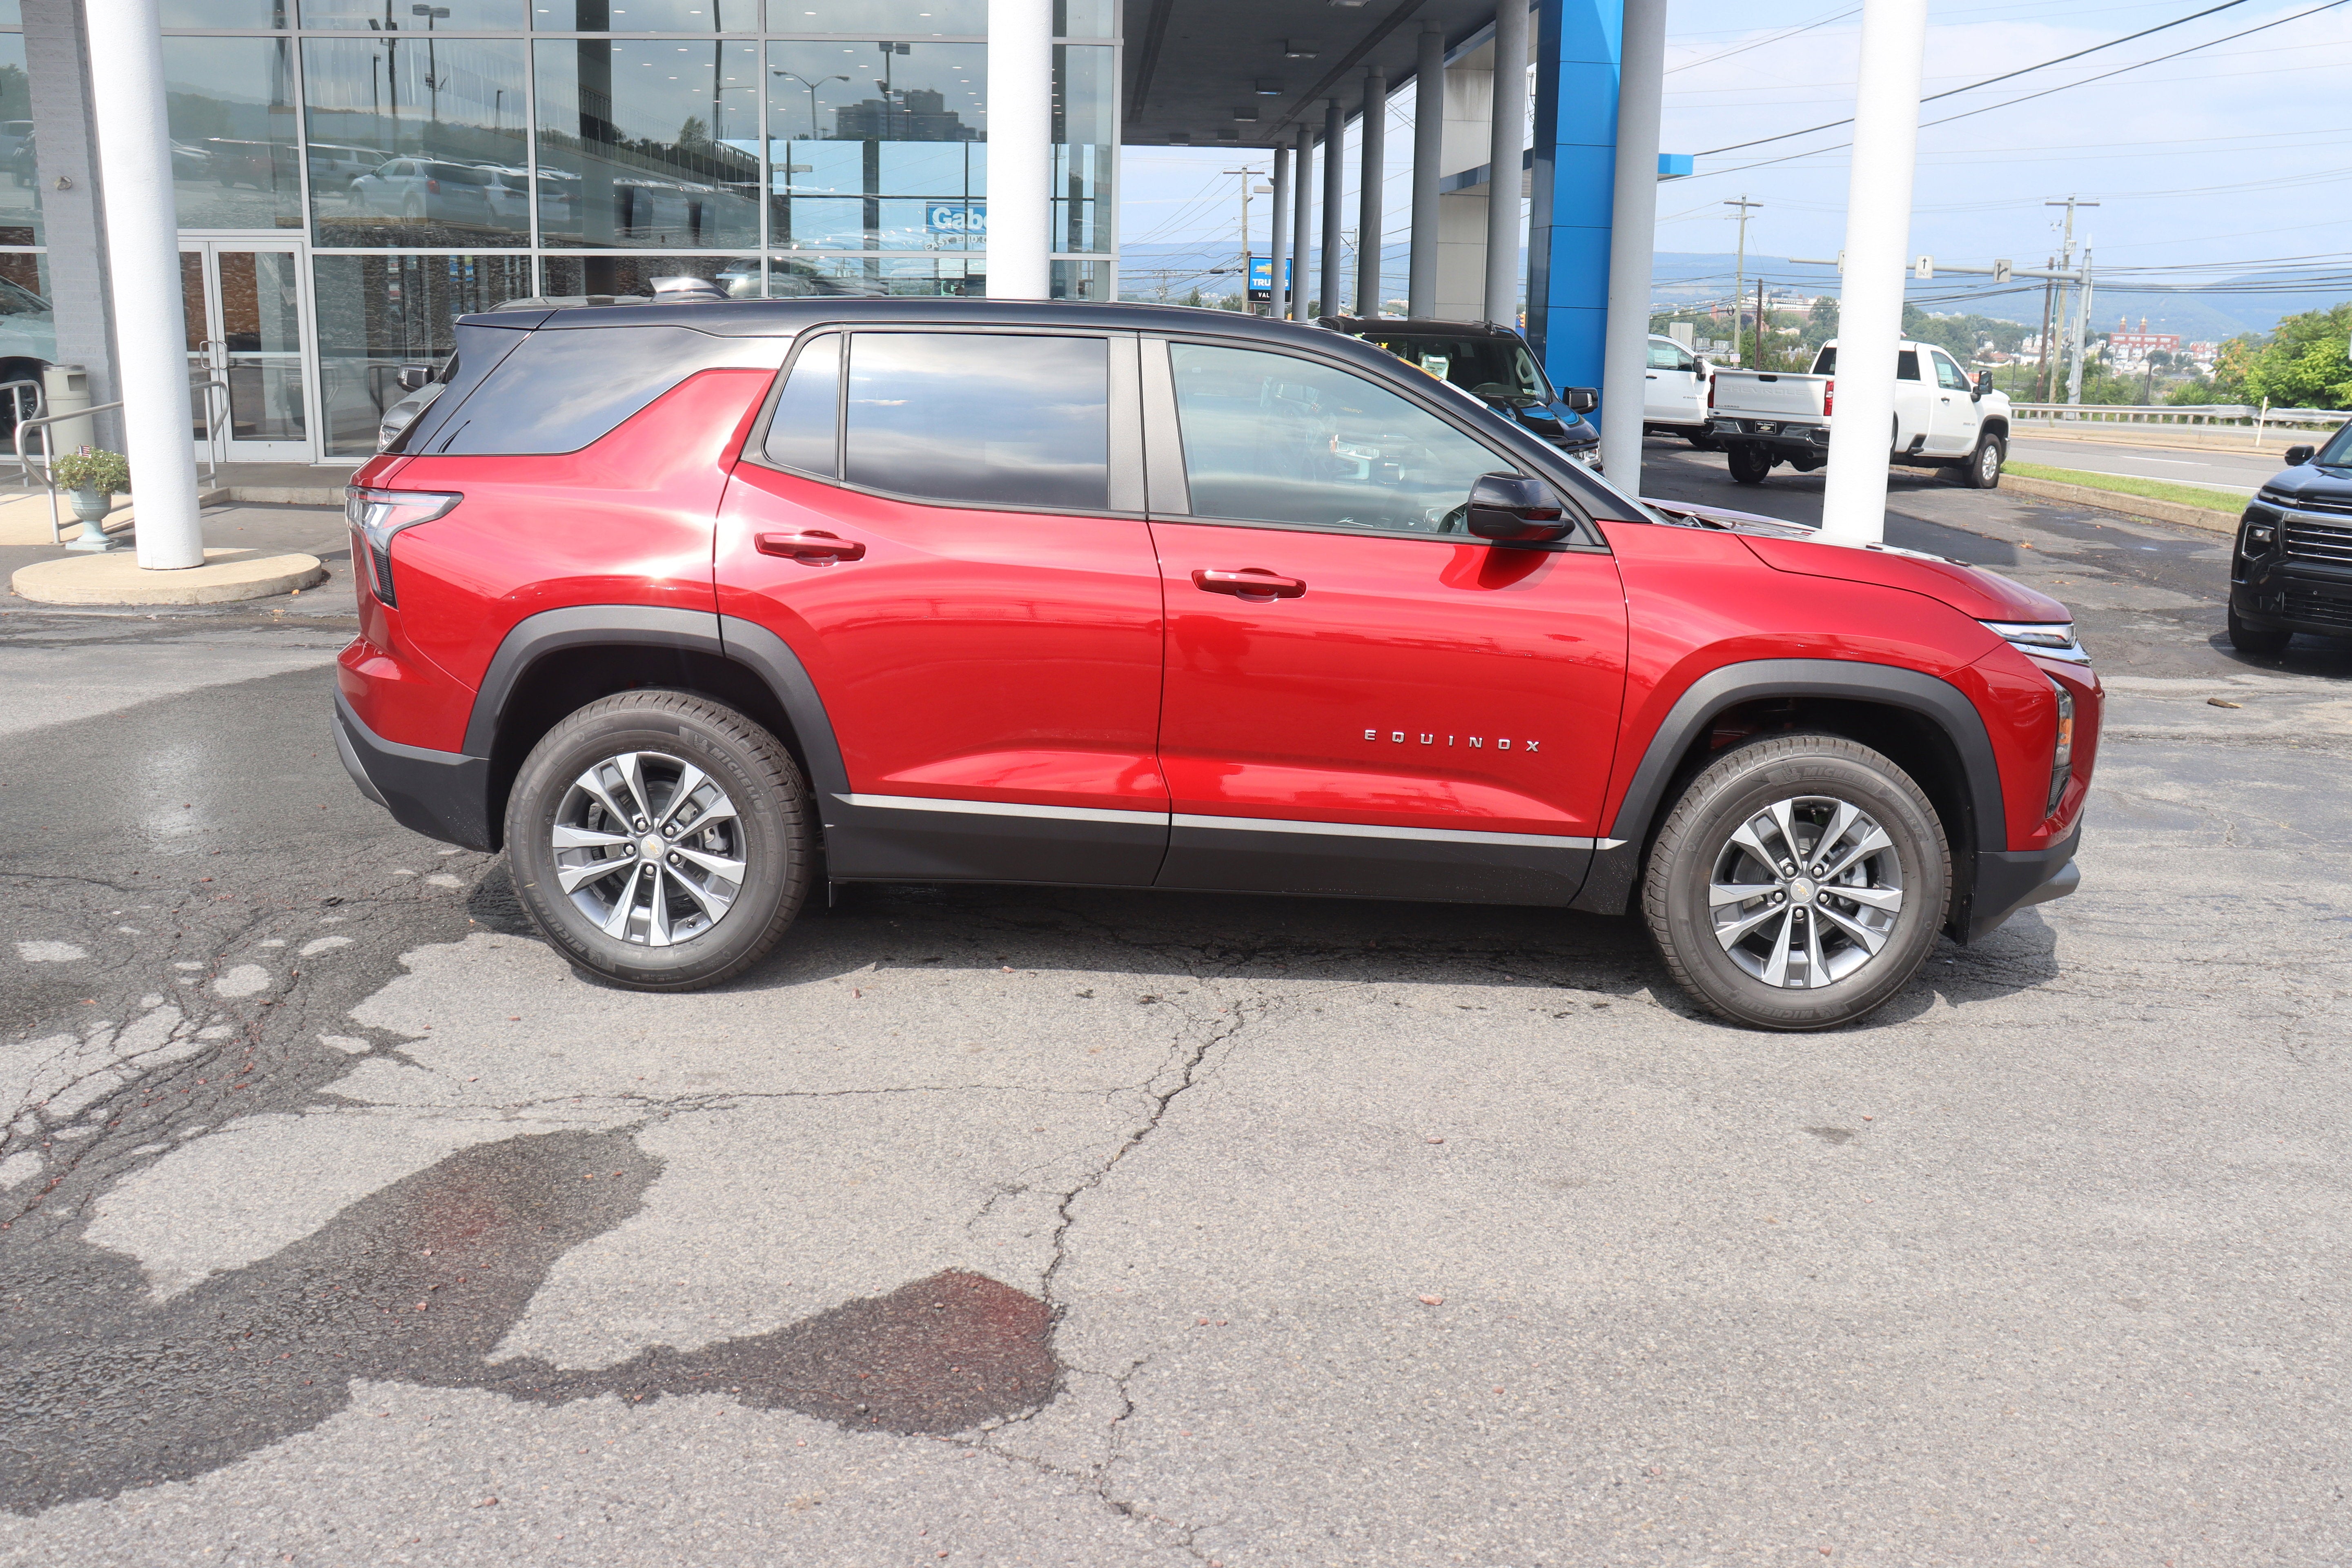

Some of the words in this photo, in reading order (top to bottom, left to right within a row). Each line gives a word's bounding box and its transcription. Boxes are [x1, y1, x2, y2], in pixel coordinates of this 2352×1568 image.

[932, 207, 987, 230] Gab
[923, 237, 951, 251] EAST
[1252, 278, 1289, 287] TRUS
[1721, 385, 1817, 397] CHEVROLET
[1364, 729, 1540, 752] EQUINOX
[709, 747, 765, 810] MICHELIN
[1803, 767, 1877, 788] MICHELIN
[532, 892, 587, 953] MICHELIN
[1738, 997, 1814, 1019] MICHELIN
